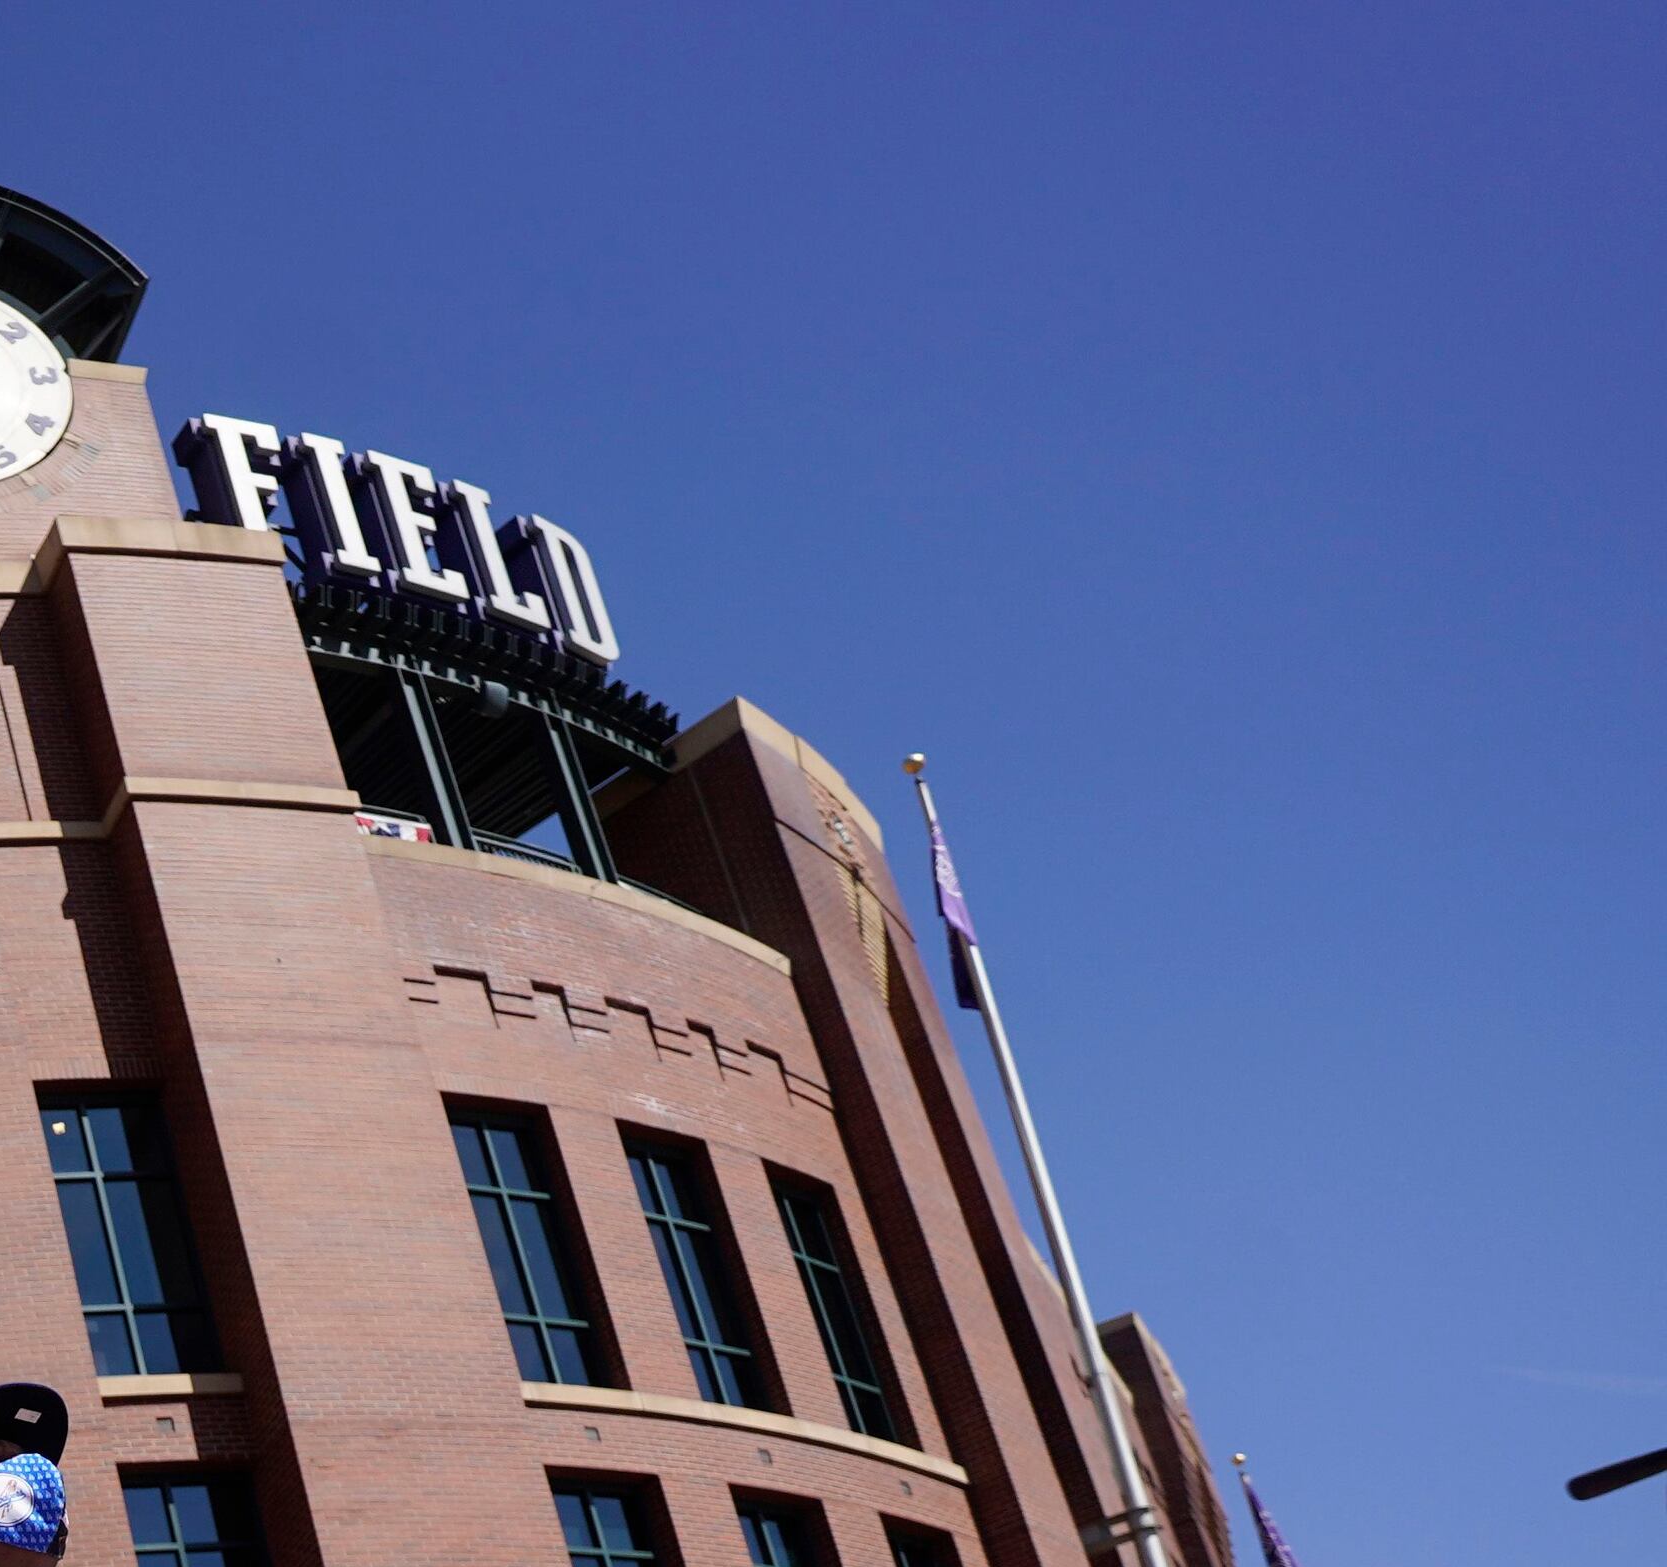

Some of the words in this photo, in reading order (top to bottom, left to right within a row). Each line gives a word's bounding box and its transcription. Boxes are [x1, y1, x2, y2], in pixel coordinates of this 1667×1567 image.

[29, 366, 58, 386] 3
[25, 412, 56, 437] 4
[197, 412, 621, 662] FIELD
